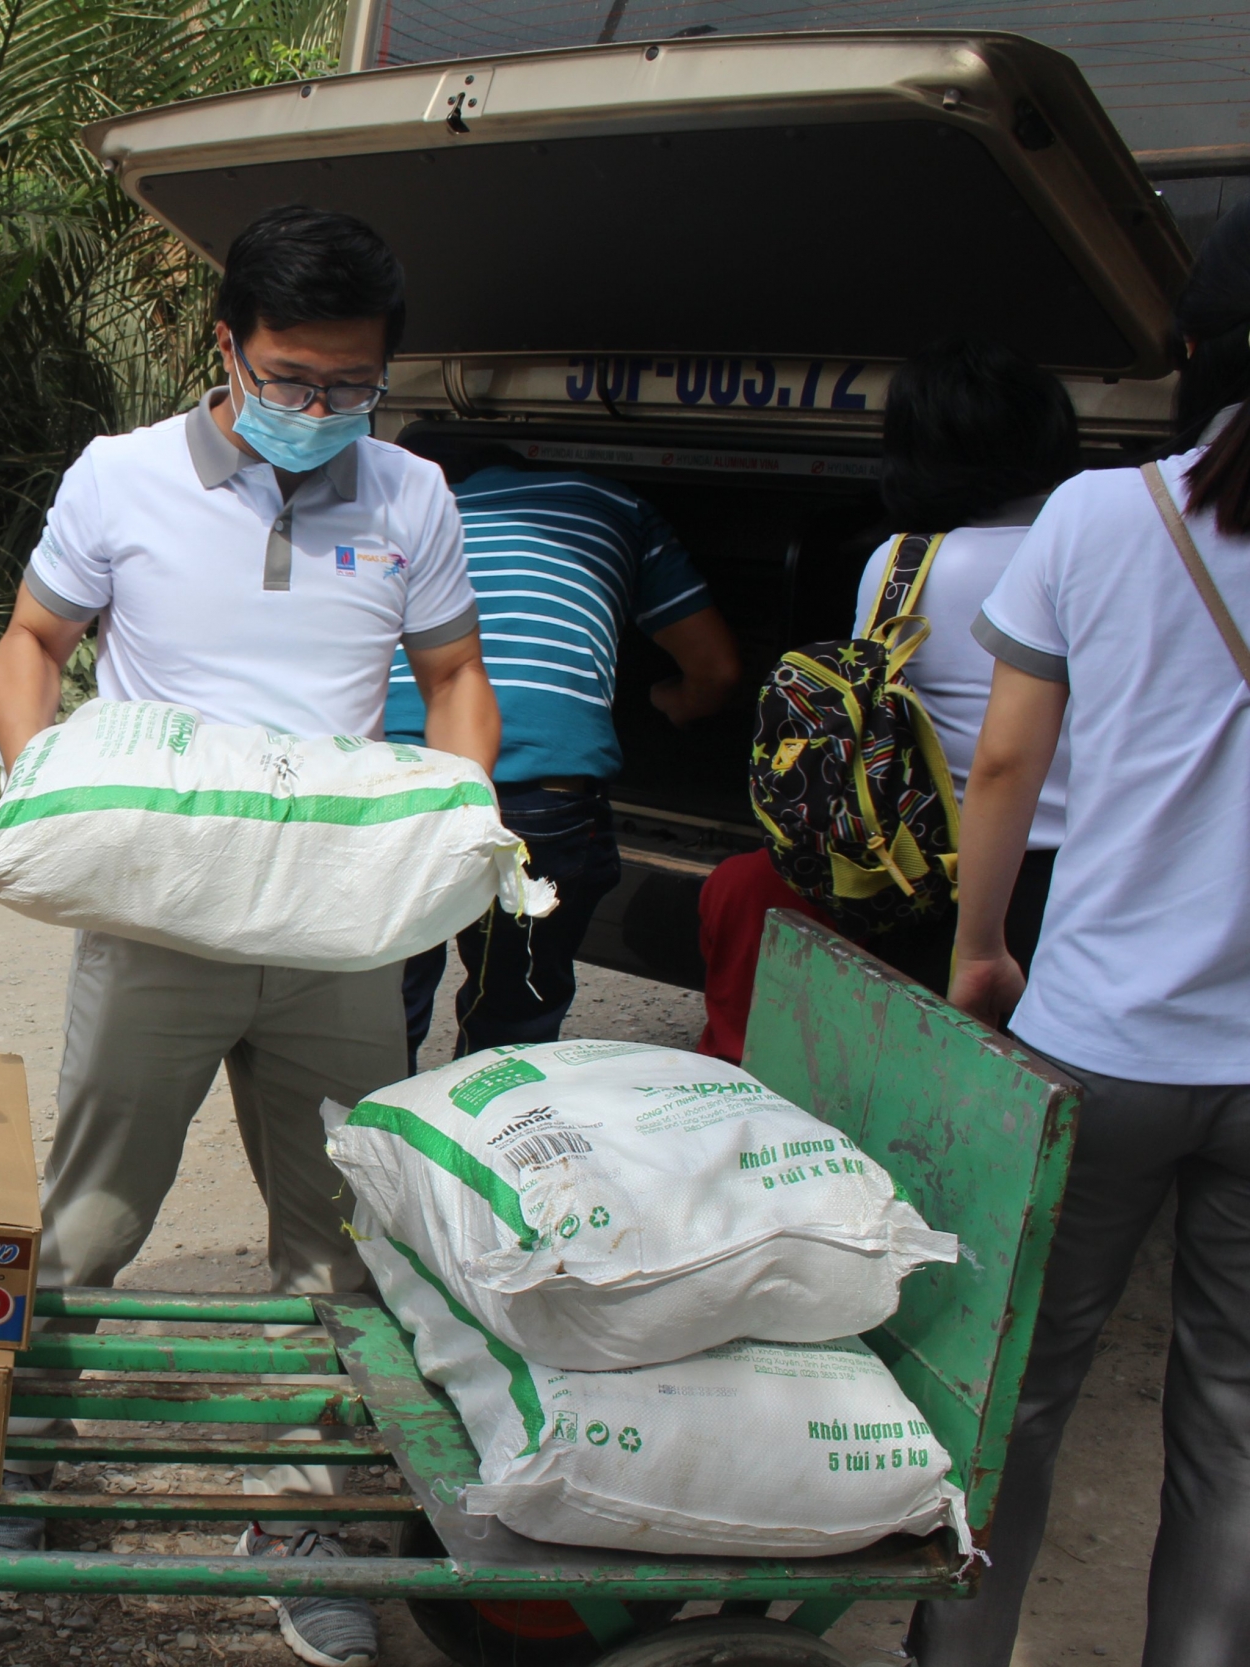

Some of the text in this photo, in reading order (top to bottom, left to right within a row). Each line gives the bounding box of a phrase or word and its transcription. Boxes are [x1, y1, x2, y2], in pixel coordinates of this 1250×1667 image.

[713, 456, 757, 469] ALUMINUM
[760, 459, 779, 470] VINA
[636, 1094, 698, 1122] CÔNG TY TNHH
[487, 1113, 552, 1145] wilmar
[740, 1139, 835, 1169] Khối lượng
[779, 1166, 806, 1185] túi
[809, 1165, 823, 1177] x
[825, 1159, 840, 1174] 5
[842, 1157, 864, 1175] kg
[733, 1354, 750, 1362] phố
[752, 1356, 773, 1366] Long
[754, 1364, 773, 1373] Điện
[758, 1348, 782, 1356] Khóm
[784, 1349, 800, 1357] Bình
[802, 1351, 818, 1360] Đức
[827, 1354, 855, 1365] Phường
[808, 1418, 848, 1441] Khối
[854, 1421, 904, 1443] lượng
[828, 1447, 928, 1471] 5 túi x 5 kg
